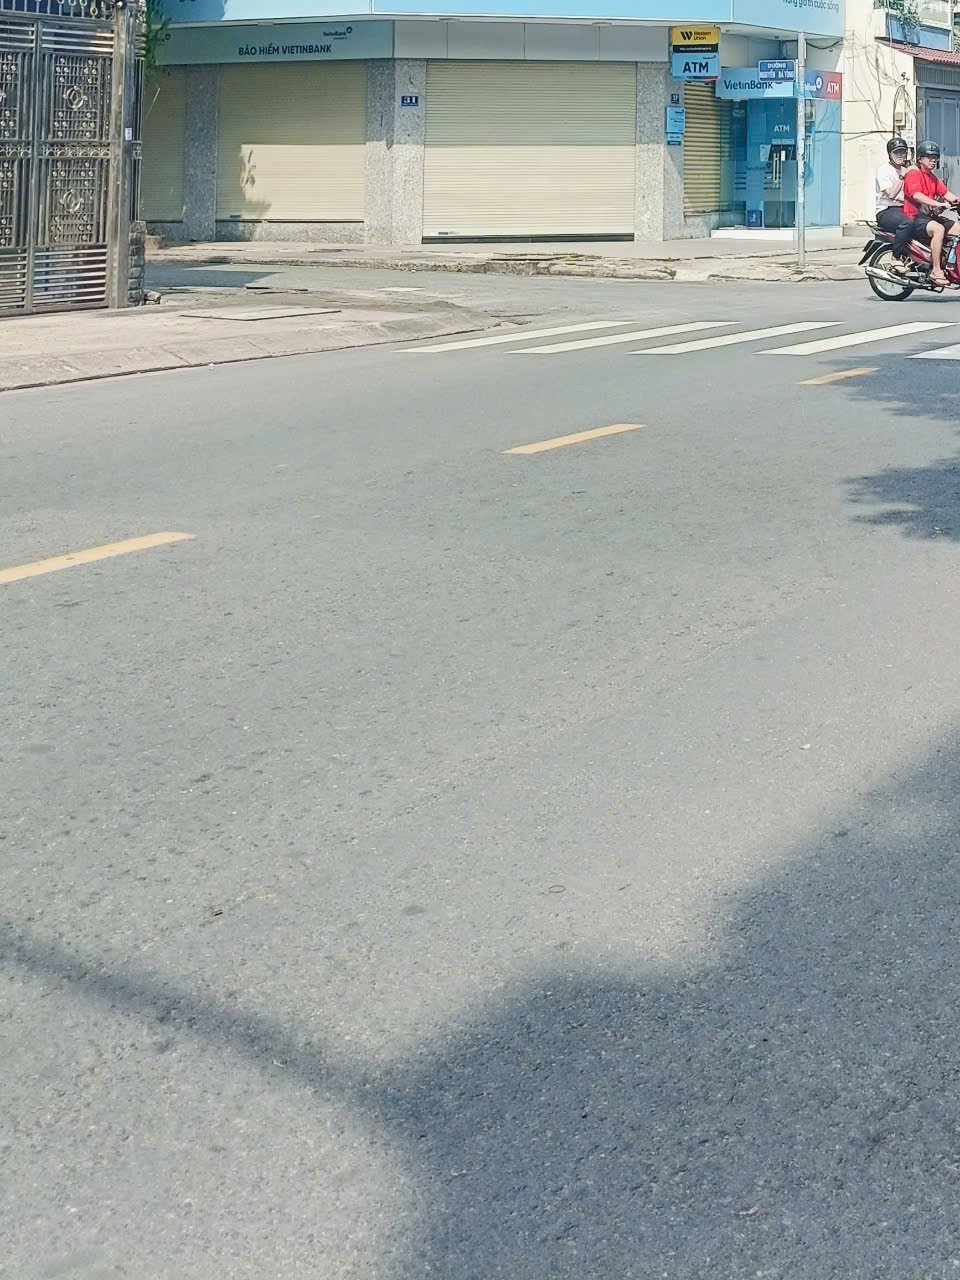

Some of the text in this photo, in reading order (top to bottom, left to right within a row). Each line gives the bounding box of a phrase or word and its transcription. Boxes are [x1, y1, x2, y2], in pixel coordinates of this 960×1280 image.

[239, 43, 332, 56] BẢO HIỂM VIETINBANK
[683, 62, 709, 72] ATM
[724, 80, 773, 90] VietinBank
[826, 82, 840, 94] ATM
